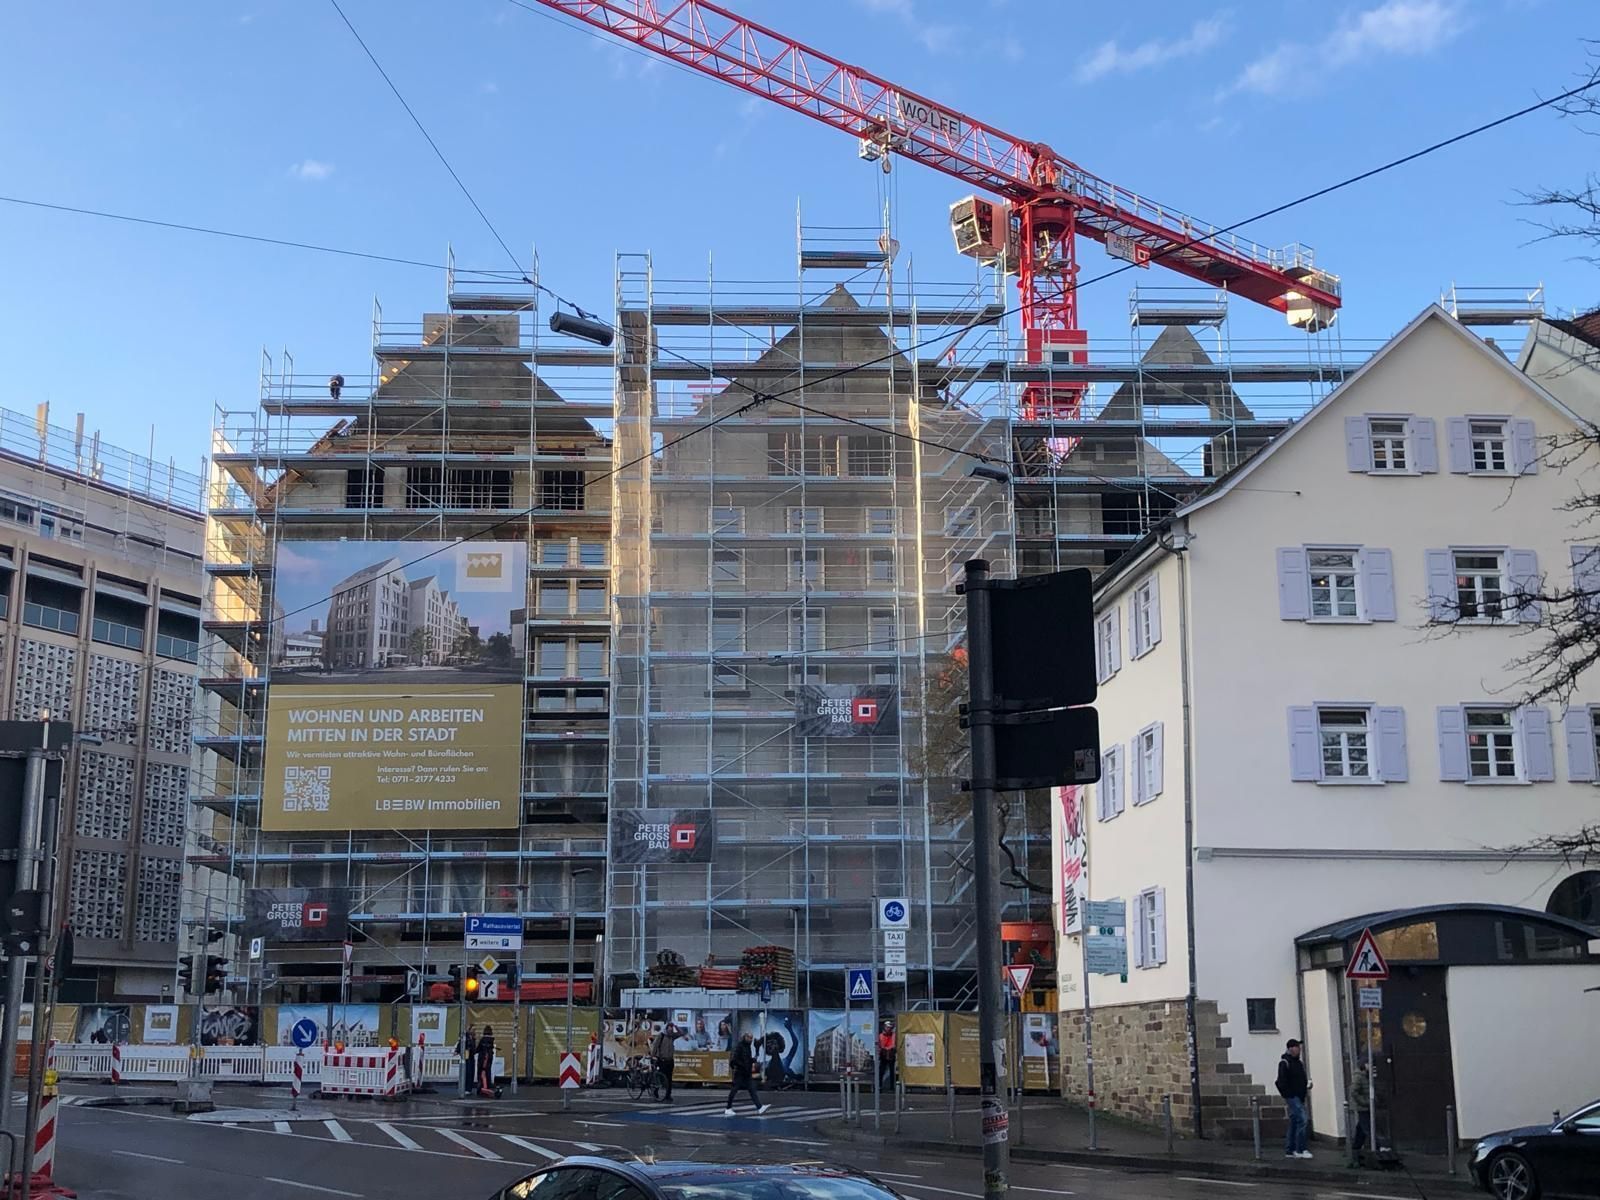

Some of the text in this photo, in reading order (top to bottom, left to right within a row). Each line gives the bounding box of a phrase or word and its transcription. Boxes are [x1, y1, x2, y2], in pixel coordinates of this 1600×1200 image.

[902, 100, 958, 135] WOLFF
[821, 698, 852, 707] PETER
[817, 706, 852, 715] GROSS
[288, 708, 484, 723] WOHNEN UND ARBEITEN
[831, 714, 852, 723] BAU
[288, 727, 458, 742] MITTEN IN DER STADT
[286, 748, 474, 759] Wir vermieten attraktive Wohn- und Büroflächen
[377, 765, 416, 773] Interesse?
[417, 764, 438, 772] Dann
[440, 764, 460, 772] rufen
[462, 764, 474, 773] Sie
[434, 775, 456, 783] 4233
[428, 798, 501, 811] Immobilien
[638, 823, 670, 832] PETER
[633, 832, 670, 841] GROSS
[648, 840, 670, 849] BAU
[271, 903, 303, 912] PETER
[266, 911, 303, 920] GROSS
[281, 919, 302, 928] BAU
